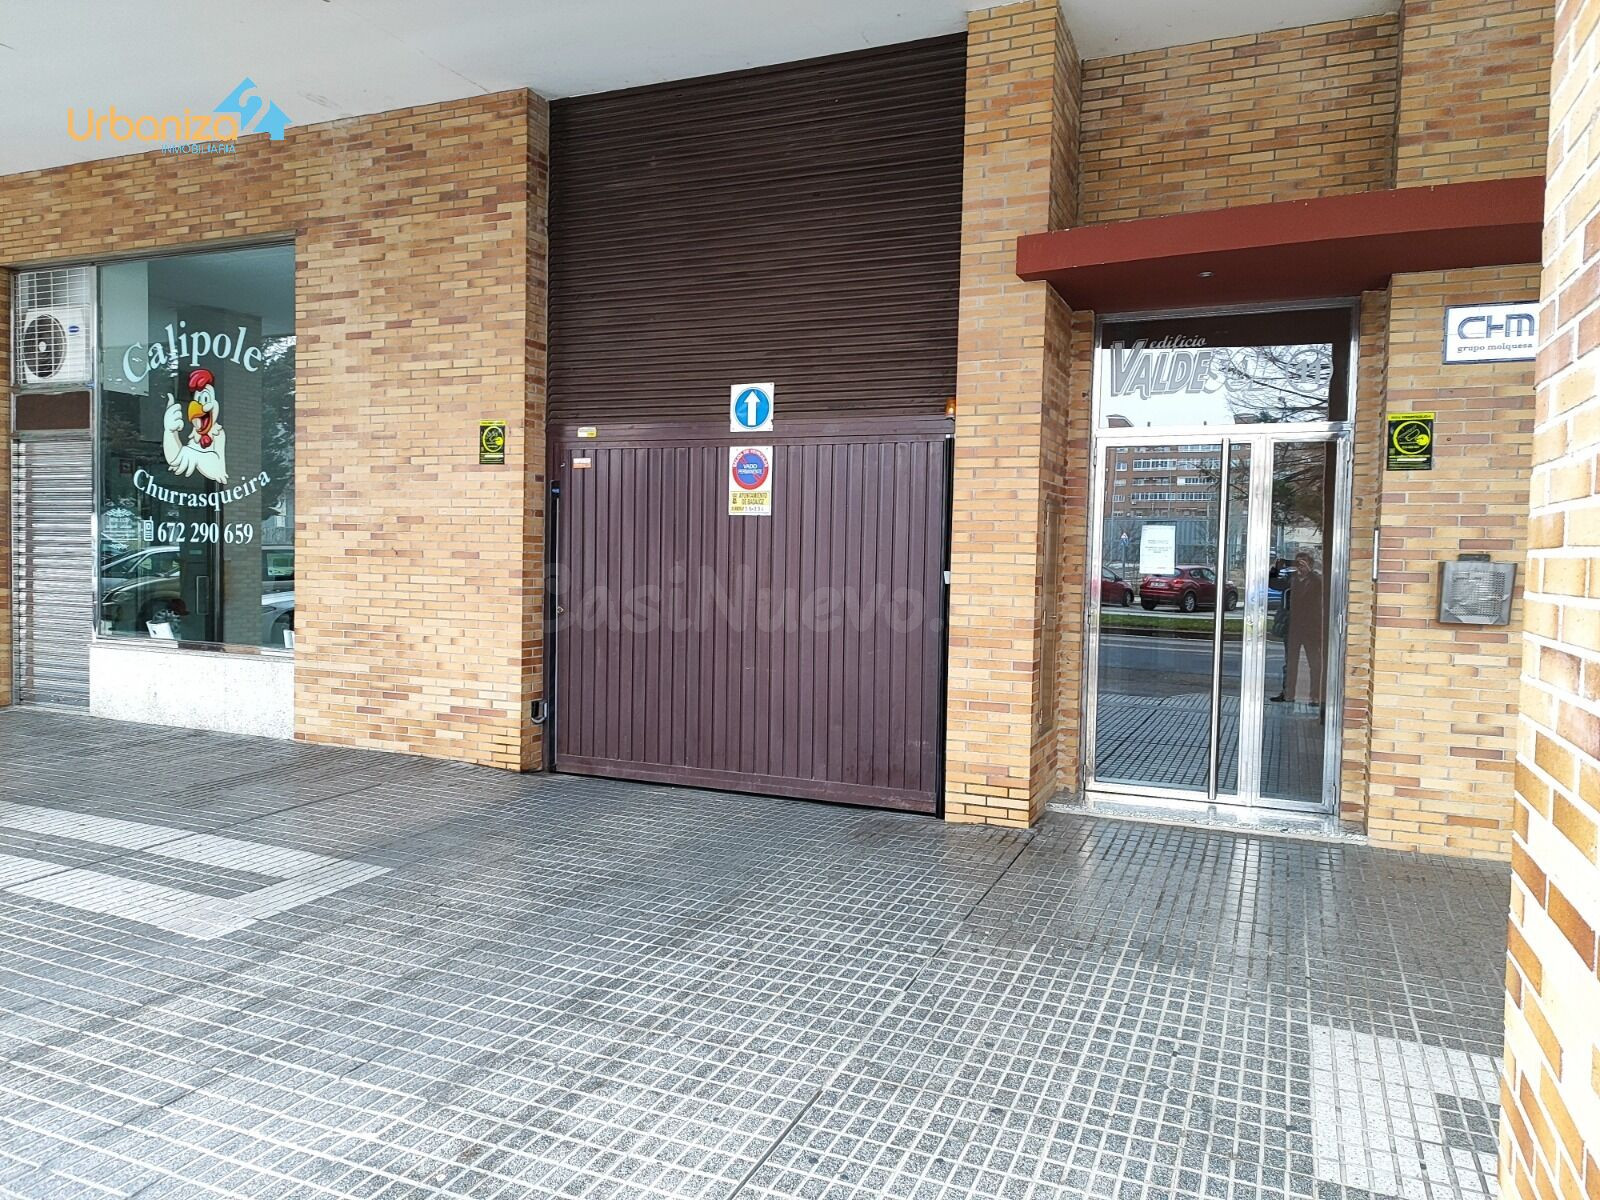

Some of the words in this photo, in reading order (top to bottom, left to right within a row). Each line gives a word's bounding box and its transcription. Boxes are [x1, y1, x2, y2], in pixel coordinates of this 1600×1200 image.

[122, 320, 263, 383] Calipole
[1150, 334, 1207, 352] edificio
[1457, 344, 1486, 354] grupo
[1487, 342, 1533, 352] molquesa
[133, 468, 271, 512] Churrasqueira
[157, 522, 186, 543] 672
[190, 522, 219, 543] 290
[224, 523, 254, 544] 659
